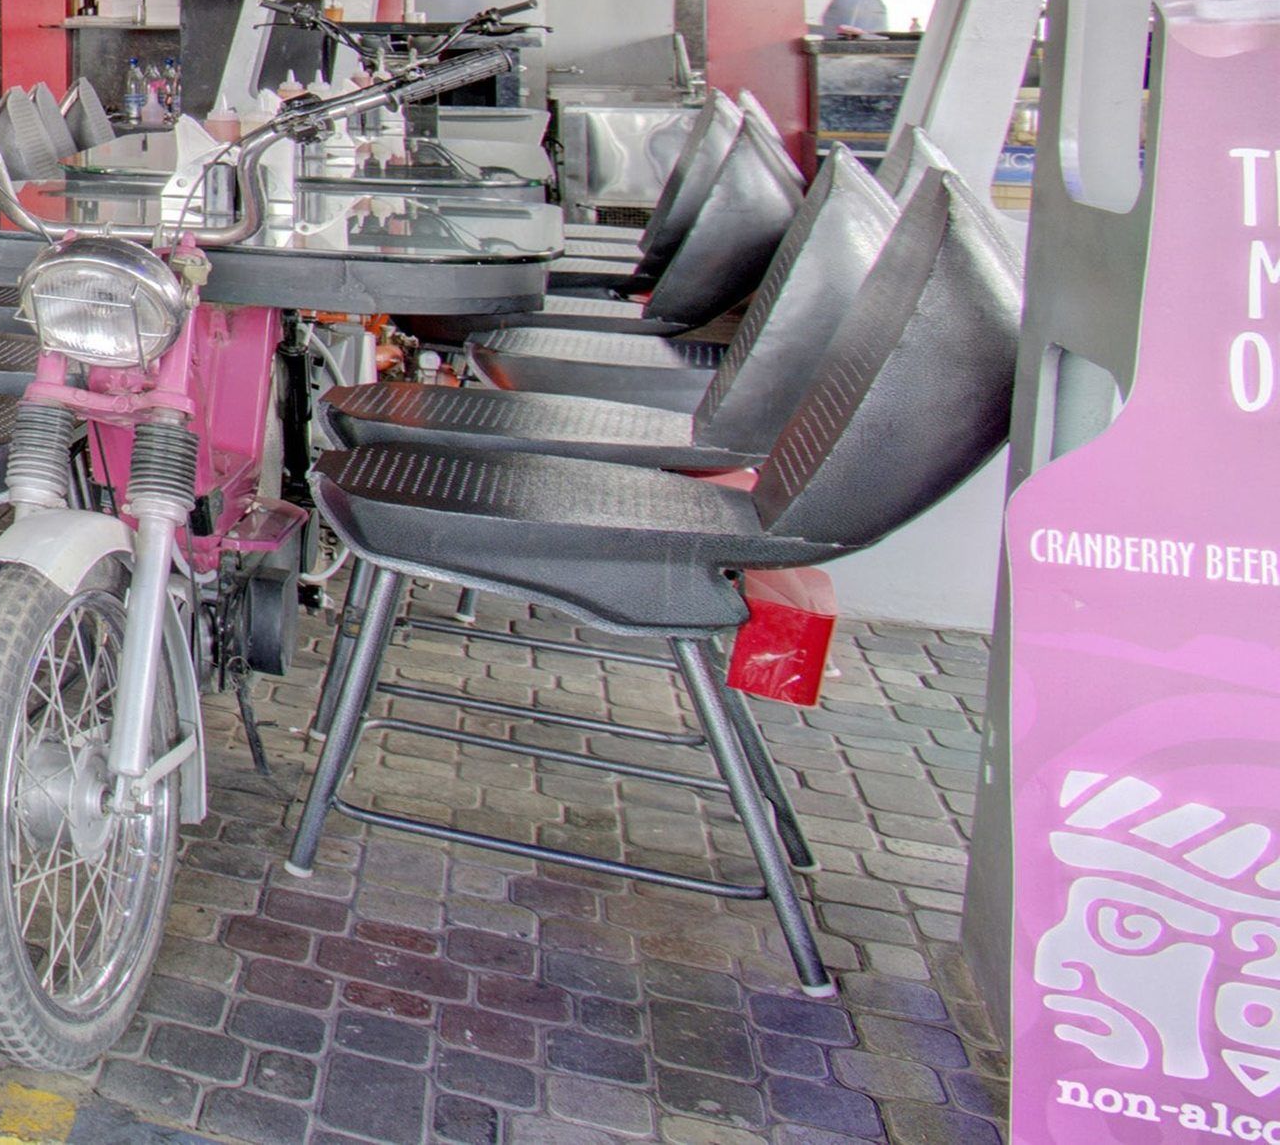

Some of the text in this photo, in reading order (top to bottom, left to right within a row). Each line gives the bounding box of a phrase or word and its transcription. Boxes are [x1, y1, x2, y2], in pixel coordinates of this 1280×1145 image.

[1229, 147, 1280, 227] T
[1030, 527, 1280, 587] CRANBERRY BEER
